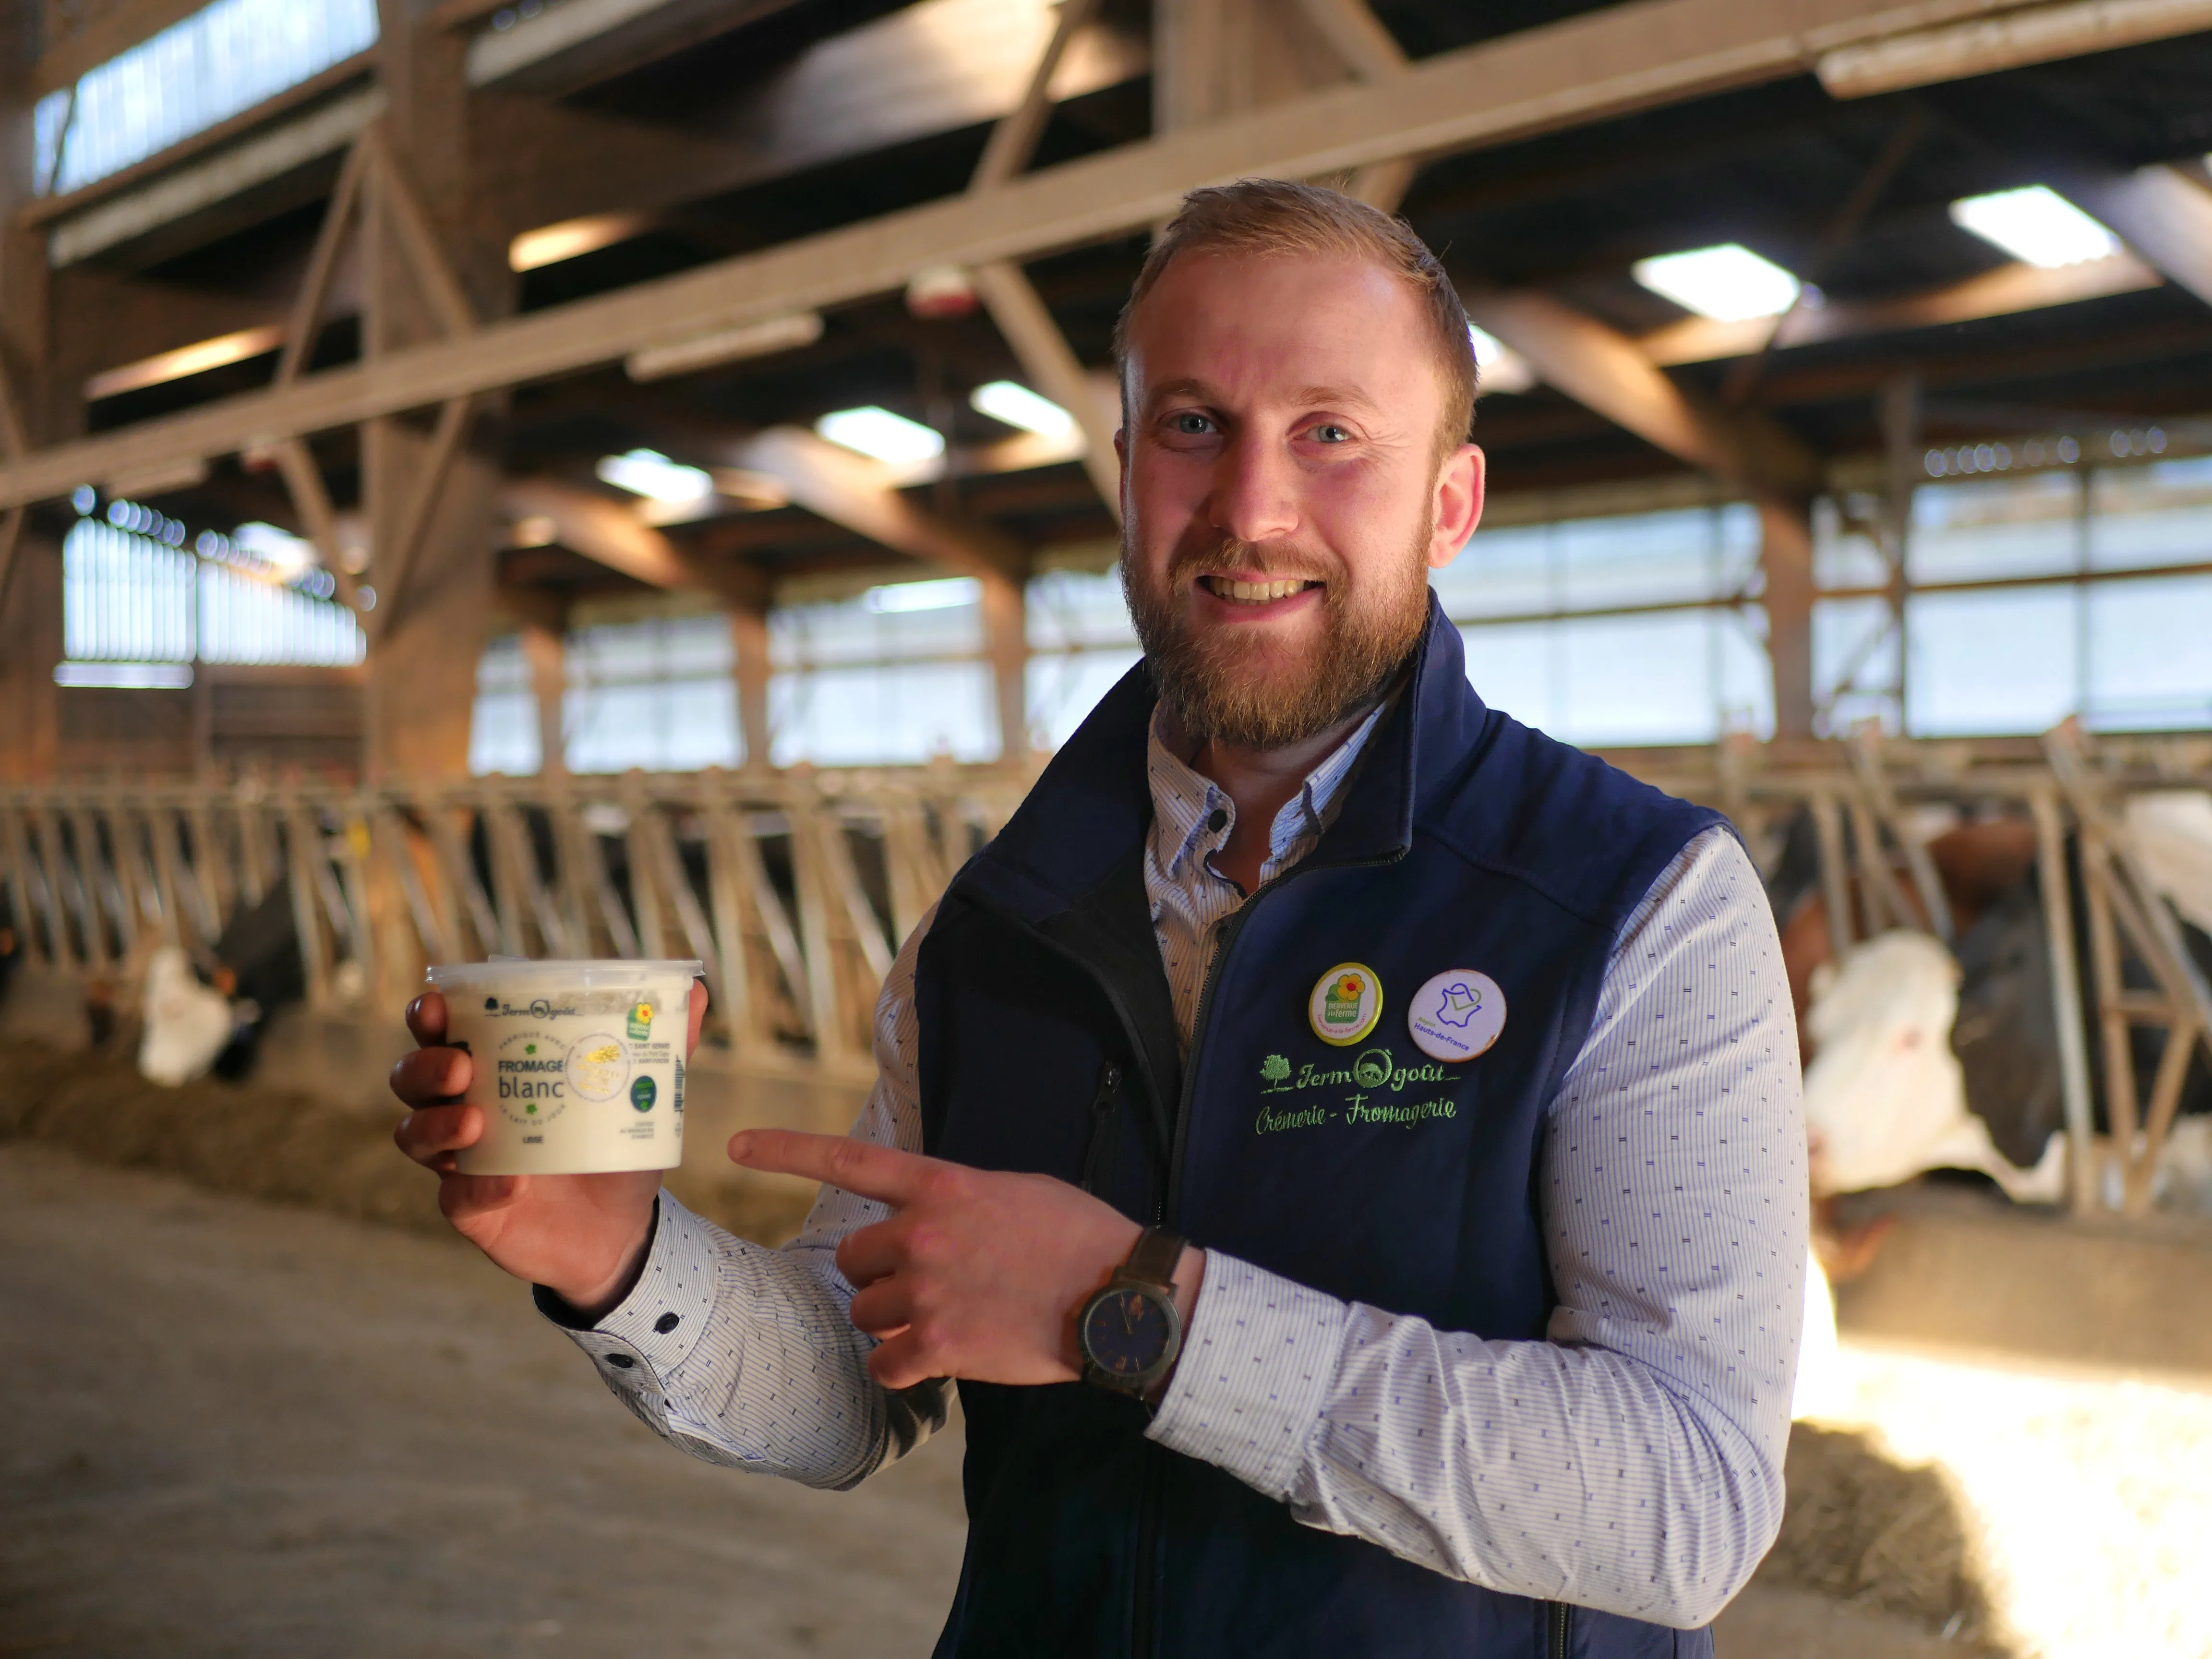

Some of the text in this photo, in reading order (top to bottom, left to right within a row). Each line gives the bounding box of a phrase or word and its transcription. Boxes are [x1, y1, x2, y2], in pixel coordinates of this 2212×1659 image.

[1335, 1009, 1357, 1017] ferme
[1414, 1022, 1469, 1051] Hauts-de-France
[498, 1060, 564, 1073] FROMAGE
[499, 1076, 565, 1099] blanc
[1255, 1106, 1326, 1135] Crémerie
[1346, 1094, 1457, 1130] Fromagerie
